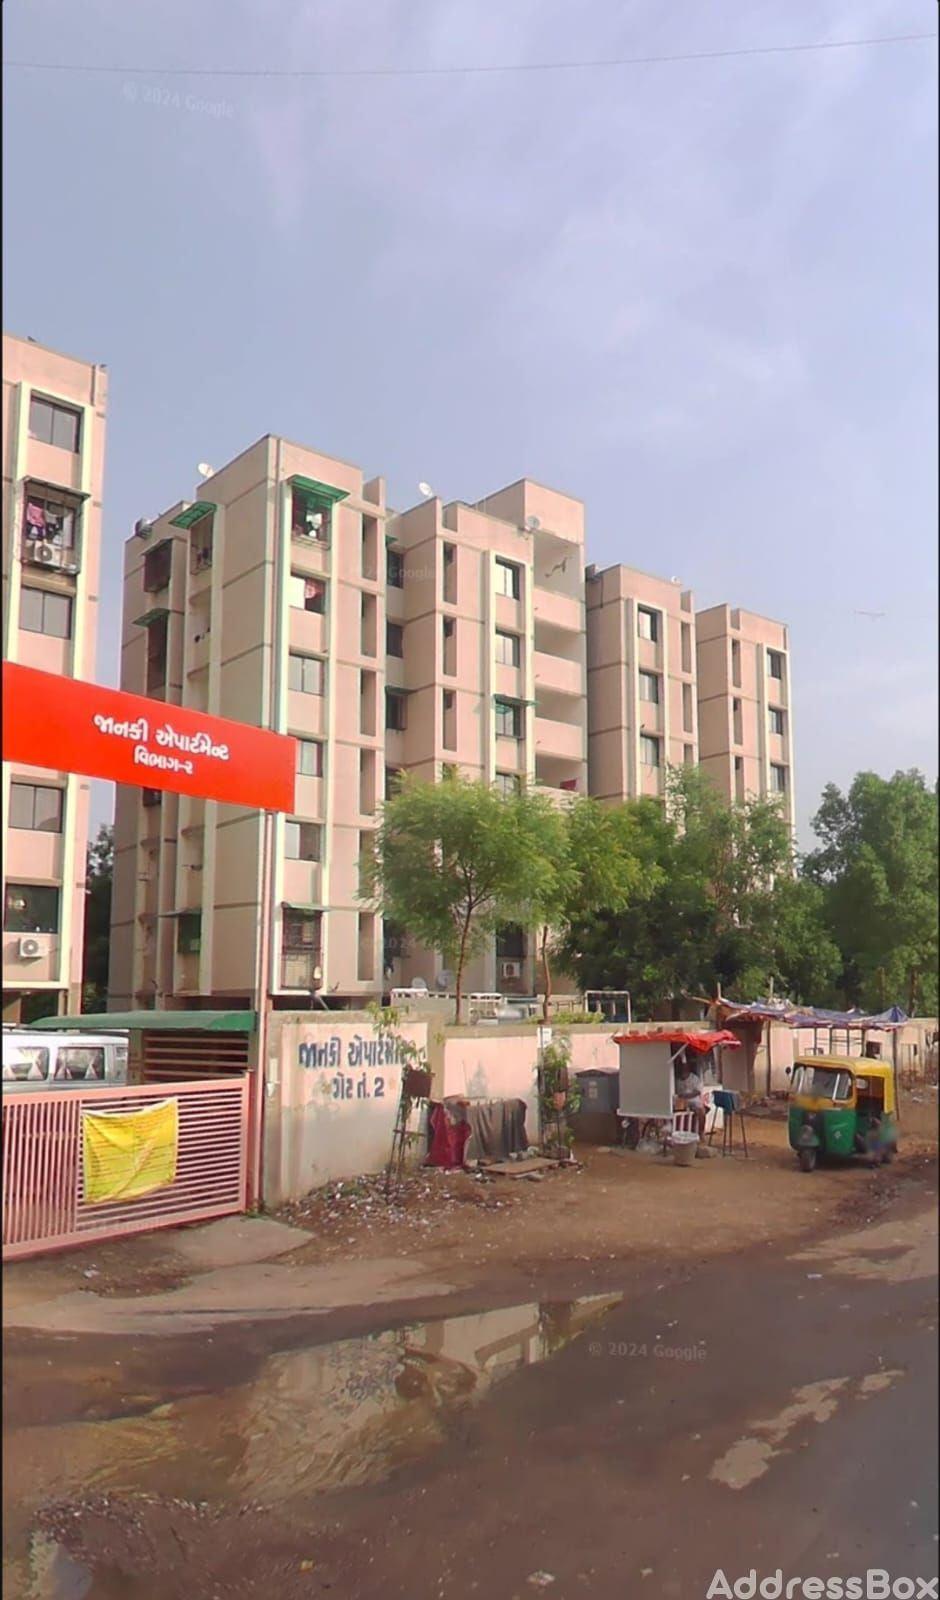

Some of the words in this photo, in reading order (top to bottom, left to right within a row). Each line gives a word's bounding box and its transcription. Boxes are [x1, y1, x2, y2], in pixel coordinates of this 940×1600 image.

[93, 713, 149, 742] જાનકી
[155, 724, 230, 760] એપાર્ટમેન્ટ
[374, 1076, 385, 1097] 2
